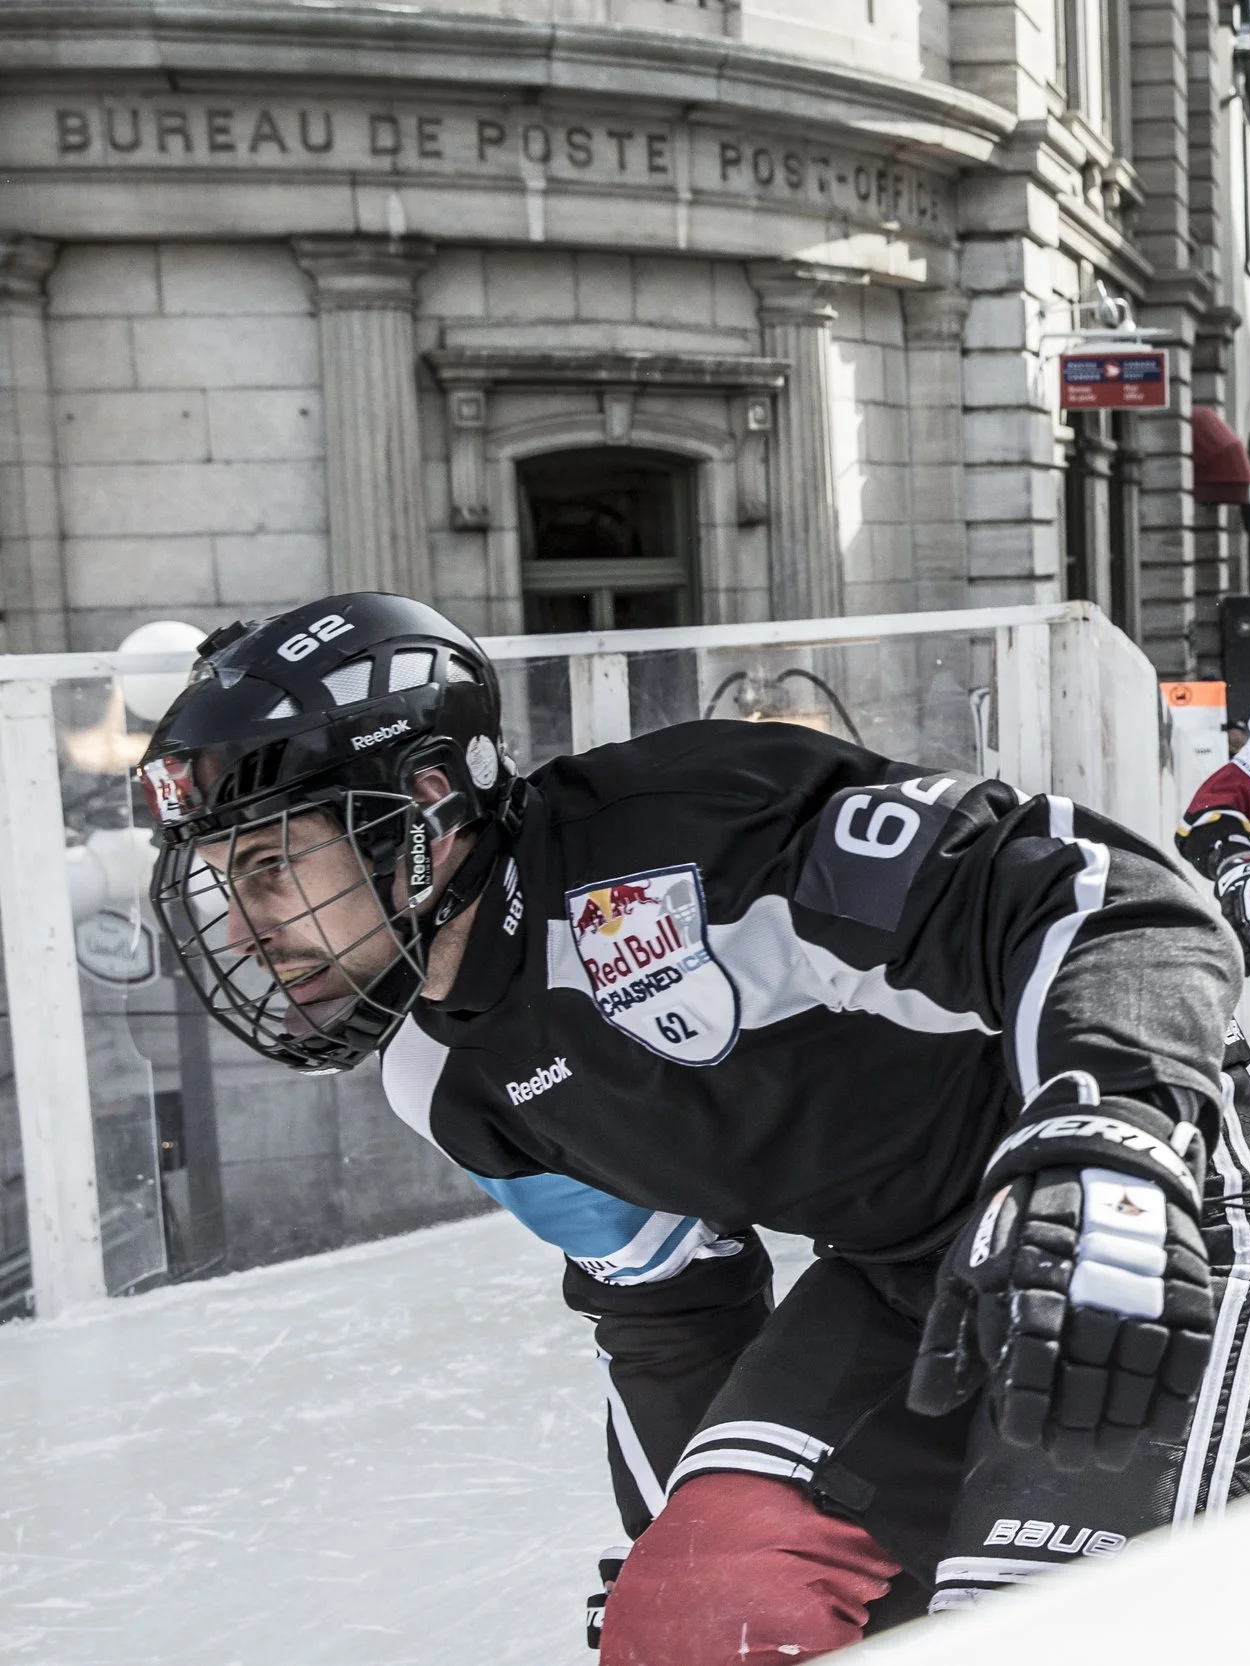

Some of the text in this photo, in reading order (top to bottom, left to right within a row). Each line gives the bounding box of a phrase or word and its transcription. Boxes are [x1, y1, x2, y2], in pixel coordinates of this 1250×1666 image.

[55, 108, 335, 155] BUREAU
[368, 114, 444, 161] DE
[476, 118, 669, 175] POSTE
[276, 613, 356, 662] 62
[352, 718, 412, 751] Reebok
[584, 915, 683, 991] Red Bull
[655, 1011, 699, 1044] 62
[505, 1056, 573, 1105] Reebok
